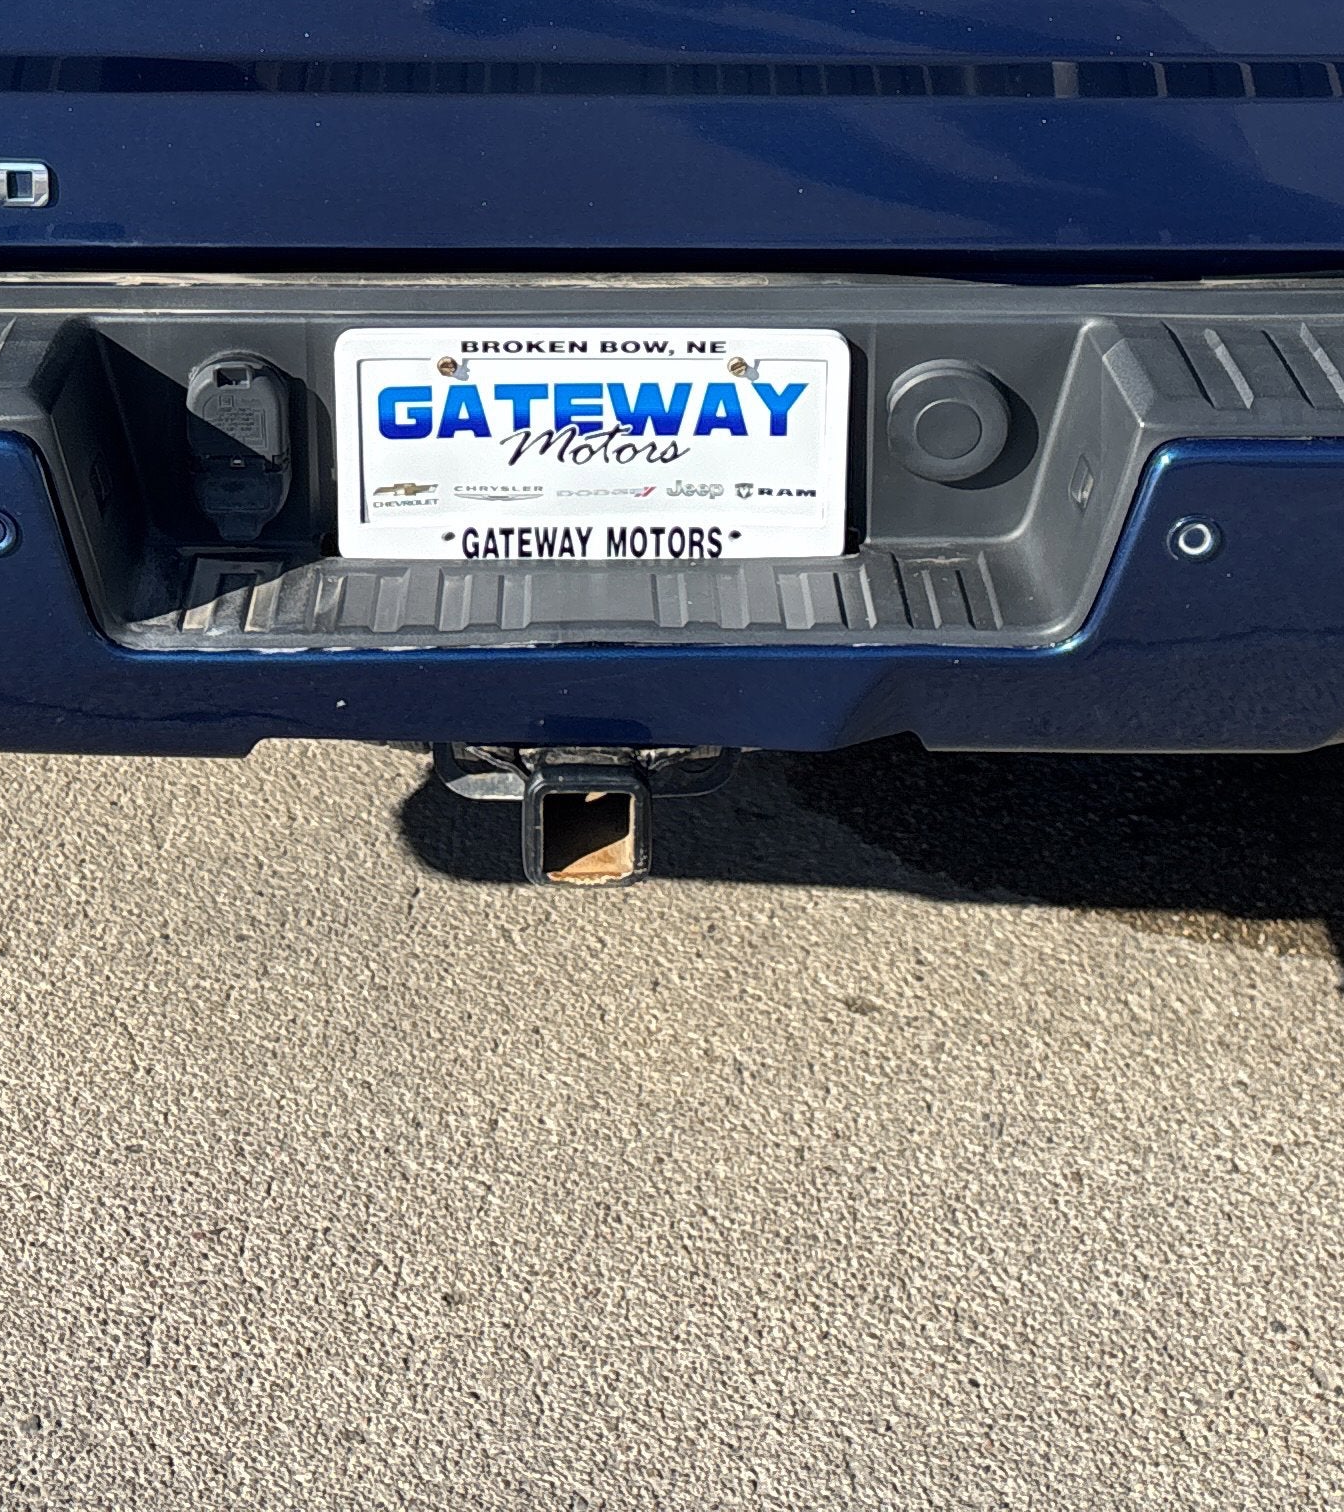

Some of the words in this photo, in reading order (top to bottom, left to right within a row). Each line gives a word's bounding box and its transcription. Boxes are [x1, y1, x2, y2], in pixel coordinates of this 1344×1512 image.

[460, 340, 589, 354] BROKEN
[599, 340, 675, 356] BOW,
[686, 340, 727, 354] NE
[377, 381, 810, 440] GATEWAY
[499, 423, 691, 467] Motors
[453, 484, 544, 493] CHRYSLER
[666, 479, 725, 500] Jeep
[757, 487, 817, 498] RAM
[372, 497, 440, 509] CHEVROLET
[462, 525, 594, 559] GATEWAY
[606, 525, 723, 559] MOTORS
